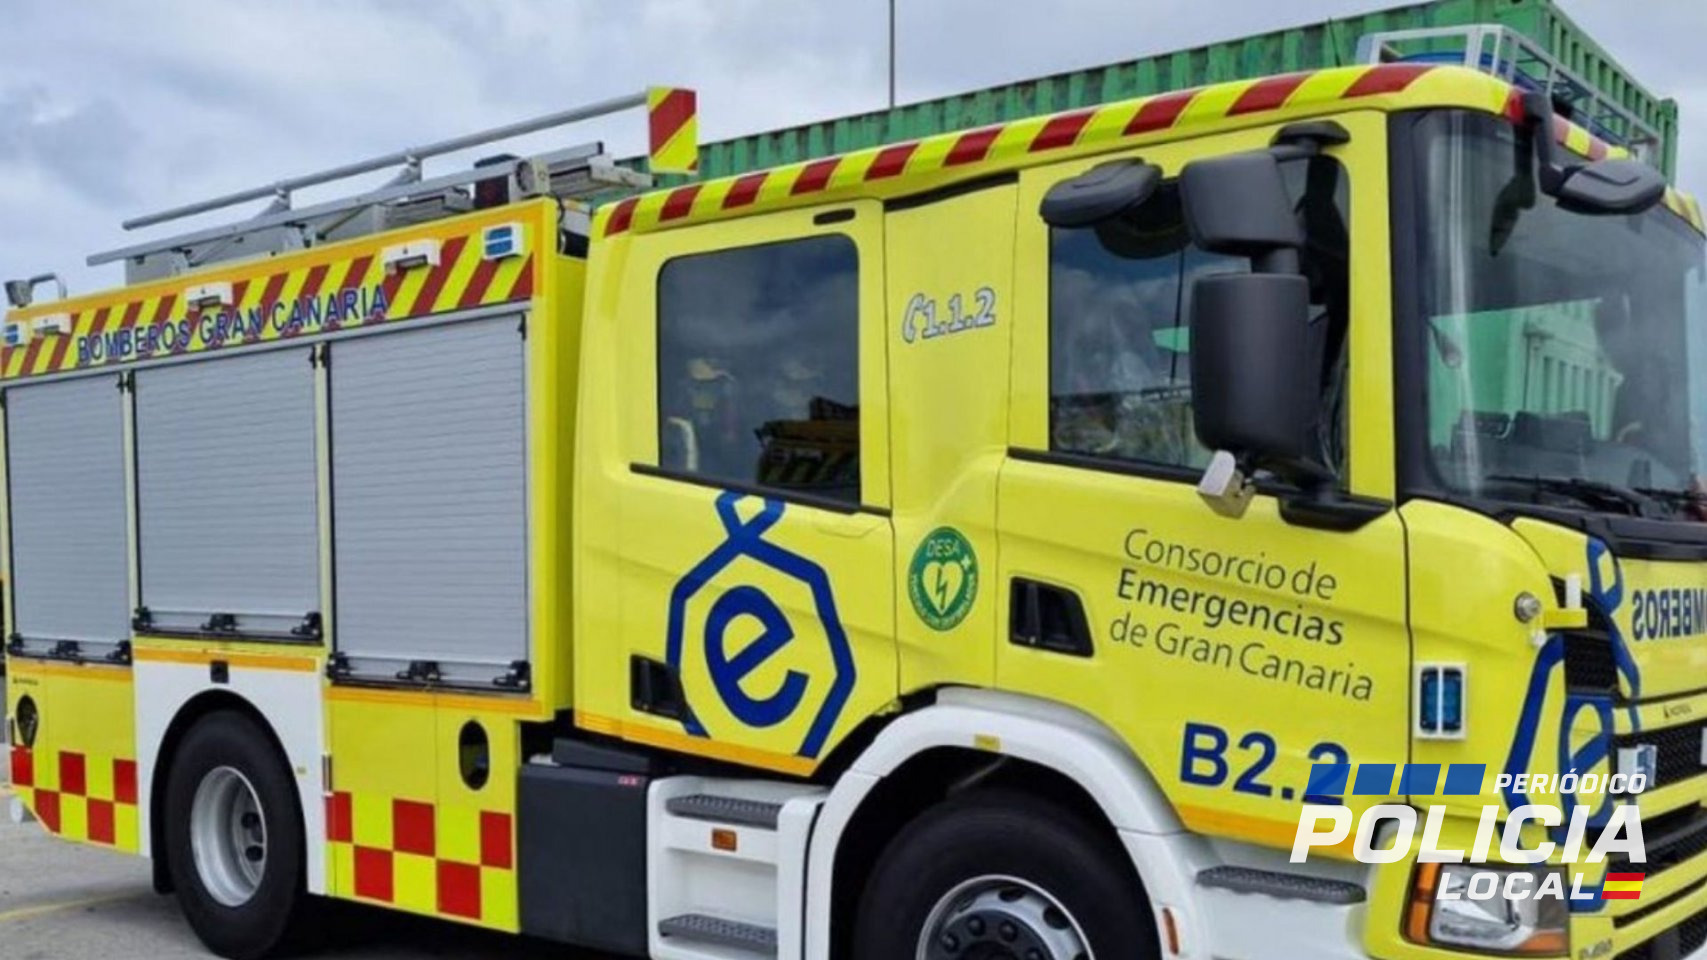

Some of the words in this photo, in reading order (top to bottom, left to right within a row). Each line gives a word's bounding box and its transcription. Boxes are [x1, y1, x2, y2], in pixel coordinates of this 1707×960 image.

[77, 319, 190, 363] BOMBEROS
[199, 306, 264, 344] GRAN
[272, 284, 387, 332] CANARIA
[926, 538, 962, 558] DESA
[1124, 529, 1286, 590] Consorcio
[1291, 561, 1337, 600] de
[1117, 568, 1344, 646] Emergencias
[1109, 612, 1148, 648] de
[1155, 622, 1233, 668] Gran
[1239, 643, 1374, 701] Canaria
[1180, 722, 1350, 806] B2.2
